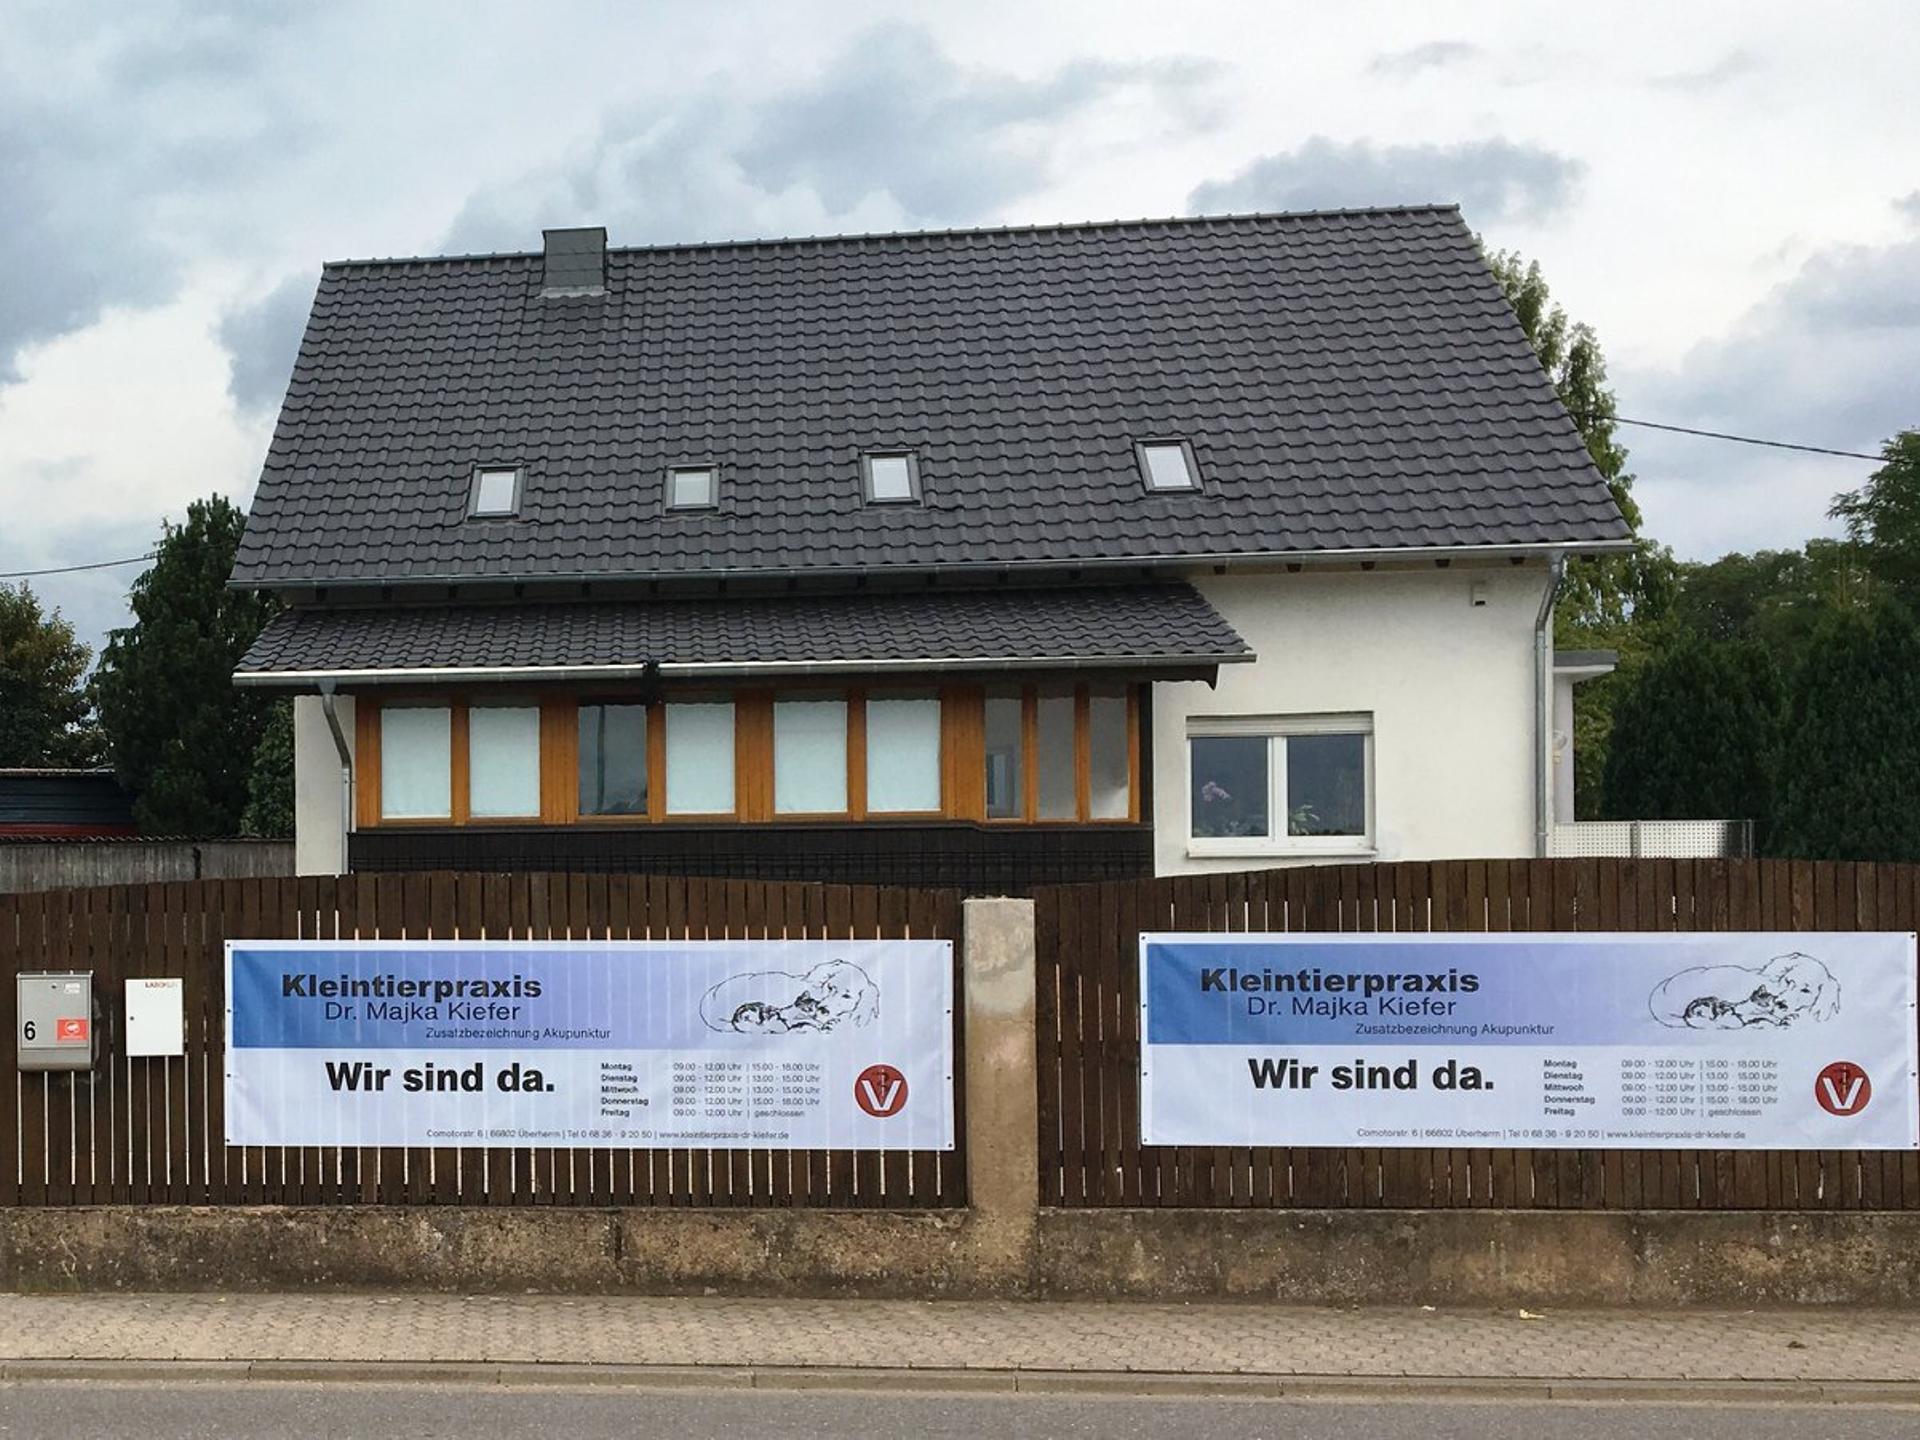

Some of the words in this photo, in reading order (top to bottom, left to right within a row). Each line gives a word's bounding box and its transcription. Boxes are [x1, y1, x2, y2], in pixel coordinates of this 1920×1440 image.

[282, 974, 542, 1002] Kleintierpraxis
[1201, 968, 1480, 998] Kleintierpraxis
[325, 1003, 357, 1020] Dr.
[367, 1002, 439, 1024] Majka
[448, 1002, 521, 1020] Kiefer
[1248, 997, 1282, 1016] Dr.
[1292, 997, 1369, 1020] Majka
[1379, 997, 1457, 1016] Kiefer
[24, 1021, 36, 1041] 6
[426, 1027, 540, 1040] Zusatzbezeichnung
[543, 1028, 611, 1040] Akupunktur
[1355, 1023, 1477, 1037] Zusatzbezeichnung
[1481, 1023, 1555, 1037] Akupunktur
[601, 1062, 632, 1071] Montag
[727, 1062, 742, 1071] Uhr
[1544, 1059, 1577, 1069] Montag
[1679, 1059, 1696, 1068] Uhr
[325, 1062, 391, 1091] Wir
[403, 1062, 483, 1092] sind
[497, 1062, 555, 1092] da.
[601, 1074, 638, 1083] Dienstag
[727, 1074, 742, 1083] Uhr
[1248, 1058, 1319, 1090] Wir
[1331, 1058, 1417, 1091] sind
[1432, 1059, 1494, 1091] da.
[1544, 1071, 1583, 1081] Dienstag
[1679, 1071, 1696, 1080] Uhr
[601, 1085, 639, 1094] Mittwoch
[727, 1086, 742, 1095] Uhr
[1544, 1083, 1584, 1092] Mittwoch
[1679, 1083, 1696, 1092] Uhr
[601, 1097, 649, 1106] Donnerstag
[727, 1097, 742, 1106] Uhr
[1544, 1095, 1595, 1105] Donnerstag
[1679, 1095, 1696, 1104] Uhr
[601, 1108, 630, 1118] Freitag
[727, 1108, 742, 1117] Uhr
[1544, 1107, 1575, 1117] Freitag
[1679, 1107, 1696, 1116] Uhr
